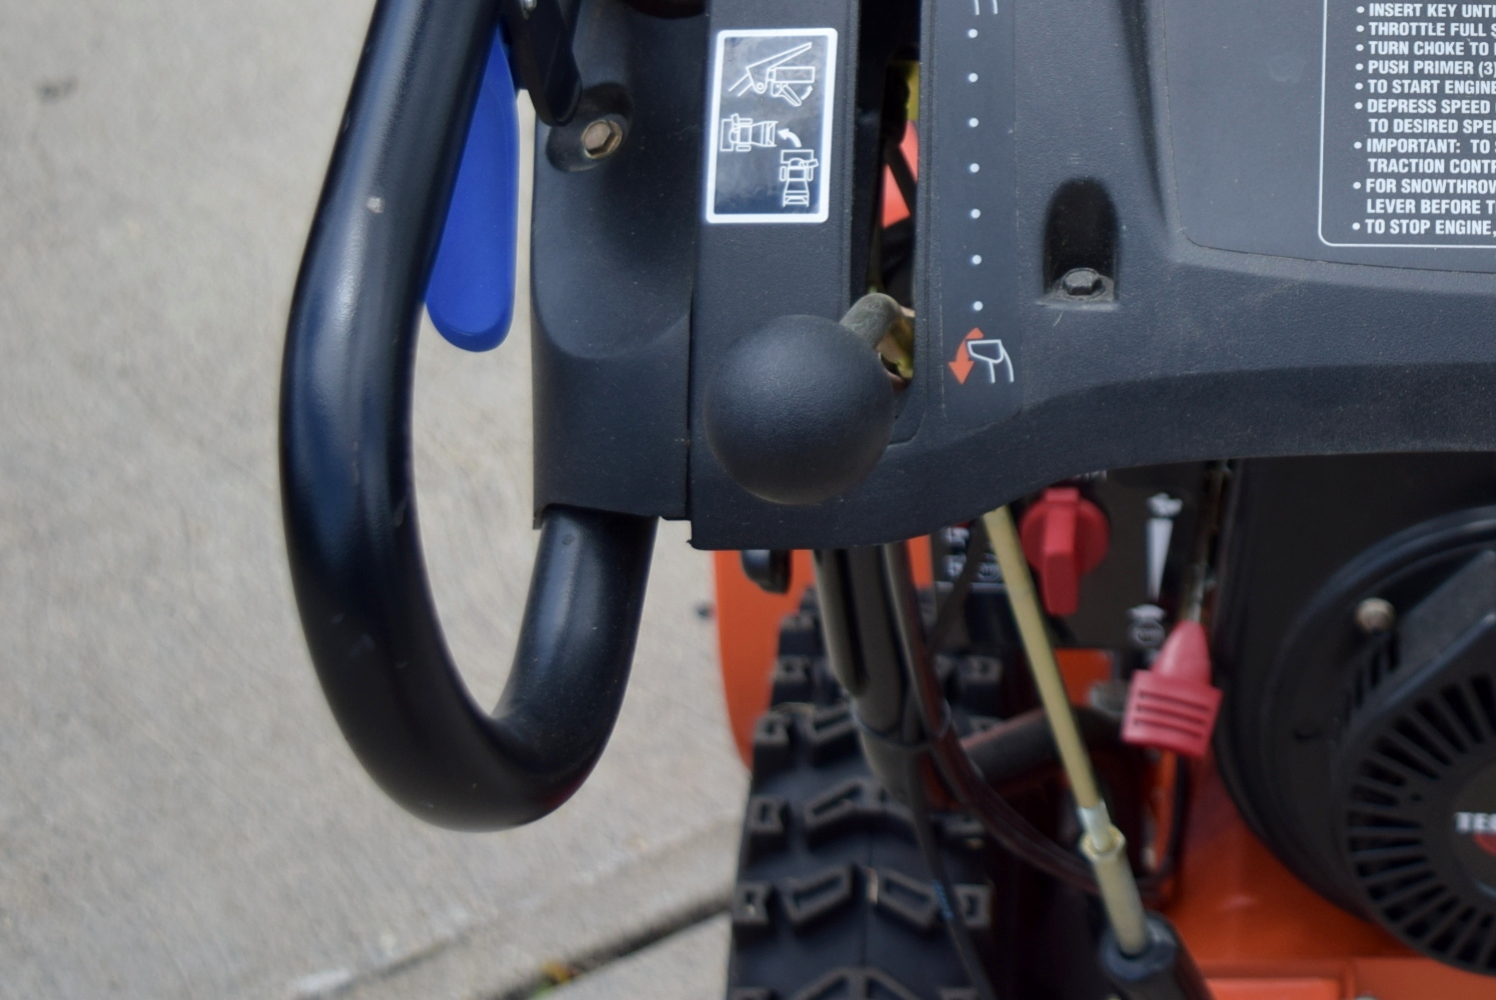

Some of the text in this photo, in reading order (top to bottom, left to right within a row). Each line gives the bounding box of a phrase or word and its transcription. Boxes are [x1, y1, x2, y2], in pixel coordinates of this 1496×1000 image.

[1370, 3, 1422, 16] INSERT
[1428, 4, 1457, 17] KEY
[1369, 22, 1445, 36] THROTTLE
[1451, 23, 1486, 36] FULL
[1369, 41, 1408, 54] TURN
[1414, 41, 1464, 55] CHOKE
[1470, 42, 1488, 55] TO
[1369, 60, 1408, 74] PUSH
[1414, 61, 1473, 74] PRIMER
[1368, 79, 1387, 93] TO
[1392, 80, 1440, 93] START
[1368, 99, 1436, 113] DEPRESS
[1441, 100, 1490, 113] SPEED
[1369, 119, 1388, 132] TO
[1394, 119, 1458, 133] DESIRED
[1367, 139, 1460, 153] IMPORTANT:
[1470, 140, 1490, 153] TO
[1368, 159, 1444, 173] TRACTION
[1366, 179, 1396, 193] FOR
[1367, 199, 1415, 213] LEVER
[1421, 199, 1480, 214] BEFORE
[1365, 219, 1385, 234] TO
[1390, 219, 1430, 234] STOP
[1436, 220, 1496, 237] ENGINE,
